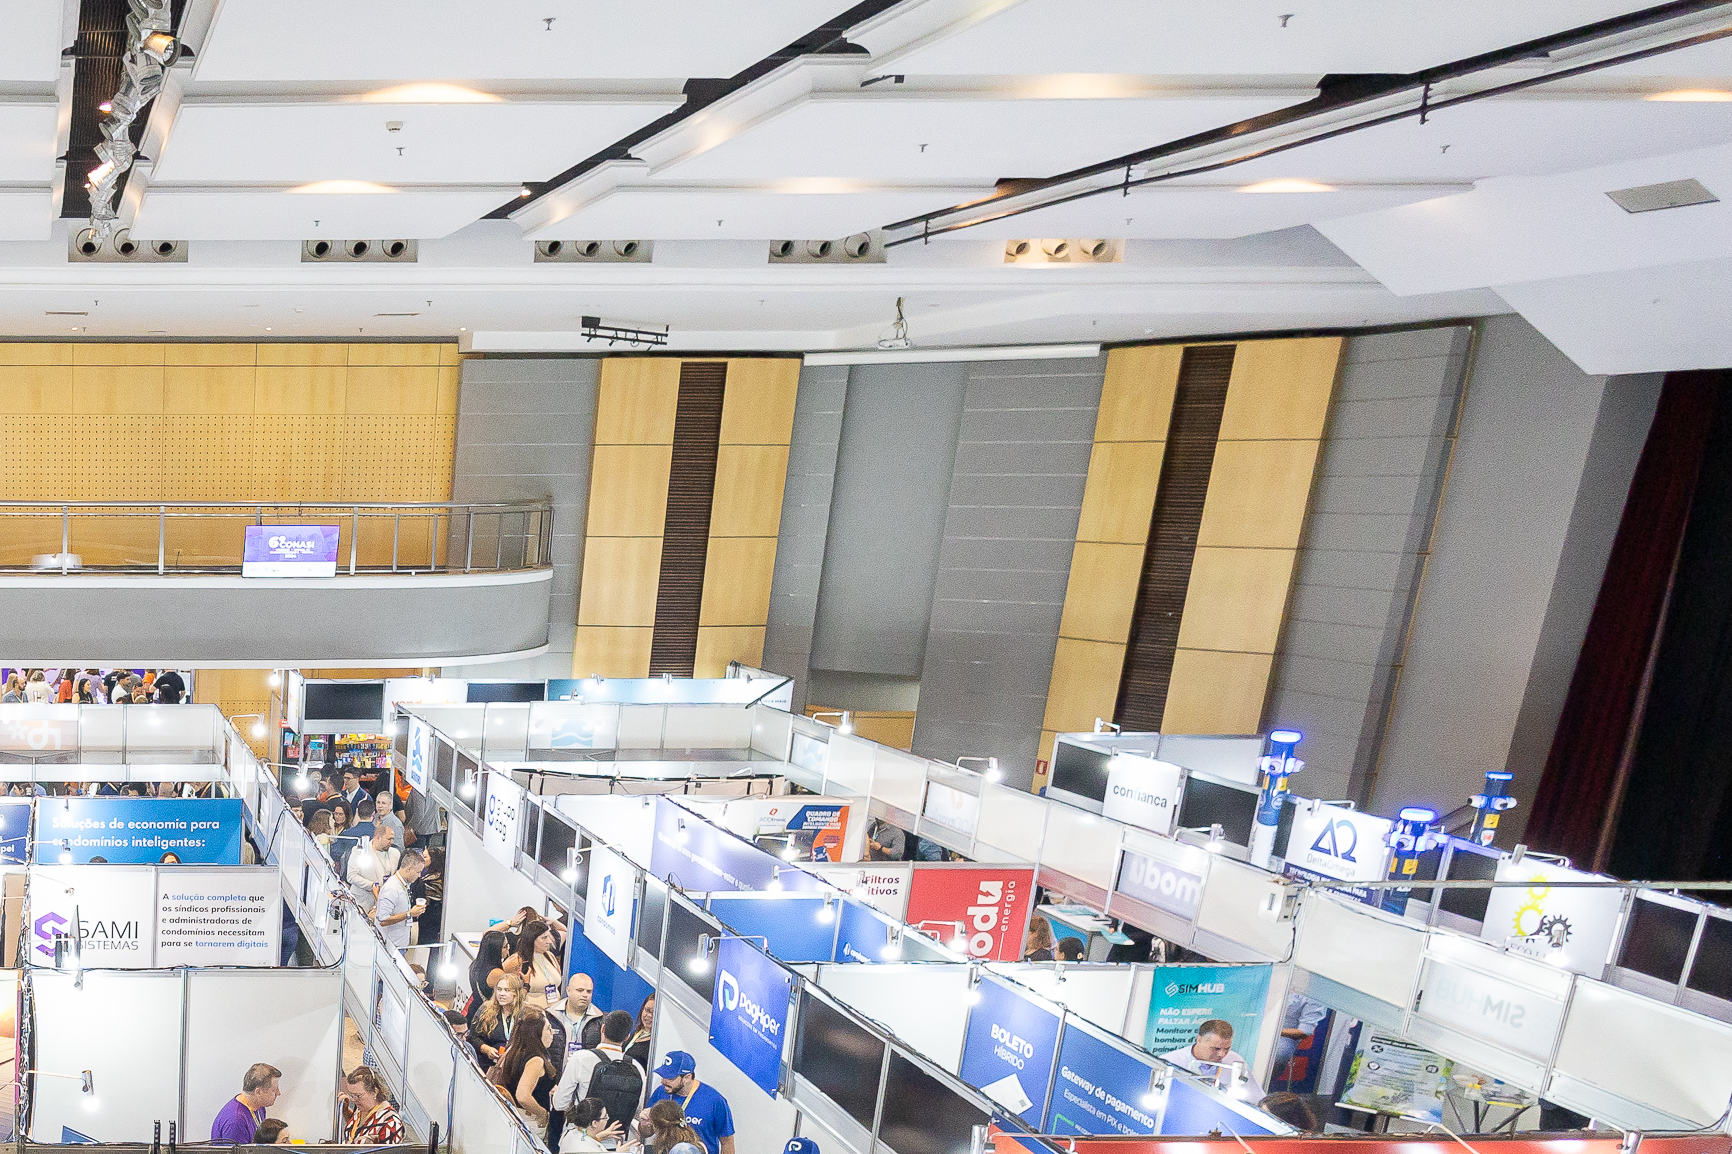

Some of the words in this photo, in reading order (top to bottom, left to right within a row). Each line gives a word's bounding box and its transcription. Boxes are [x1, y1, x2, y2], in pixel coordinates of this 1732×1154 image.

[1112, 784, 1168, 808] confiança
[109, 819, 125, 831] de
[128, 818, 187, 831] economia
[190, 821, 220, 834] para
[131, 835, 206, 851] inteligentes:
[1306, 853, 1356, 878] DeltaOmega
[171, 893, 205, 903] solução
[207, 893, 246, 904] completa
[248, 895, 265, 904] que
[1001, 881, 1016, 932] energia
[174, 904, 208, 913] síndicos
[211, 904, 266, 916] profissionais
[168, 916, 239, 924] administradoras
[241, 916, 253, 924] de
[970, 880, 1004, 959] odu
[161, 928, 216, 936] condomínios
[217, 928, 265, 936] necessitam
[161, 941, 180, 949] para
[237, 939, 269, 950] digitais
[1179, 982, 1225, 995] SIMHUB
[1156, 1027, 1191, 1035] Monitore
[990, 1023, 1034, 1060] BOLETO
[993, 1043, 1025, 1071] HÍBRIDO
[1061, 1065, 1096, 1096] Gateway
[1105, 1093, 1155, 1129] pagamento
[1063, 1088, 1096, 1115] Especialista
